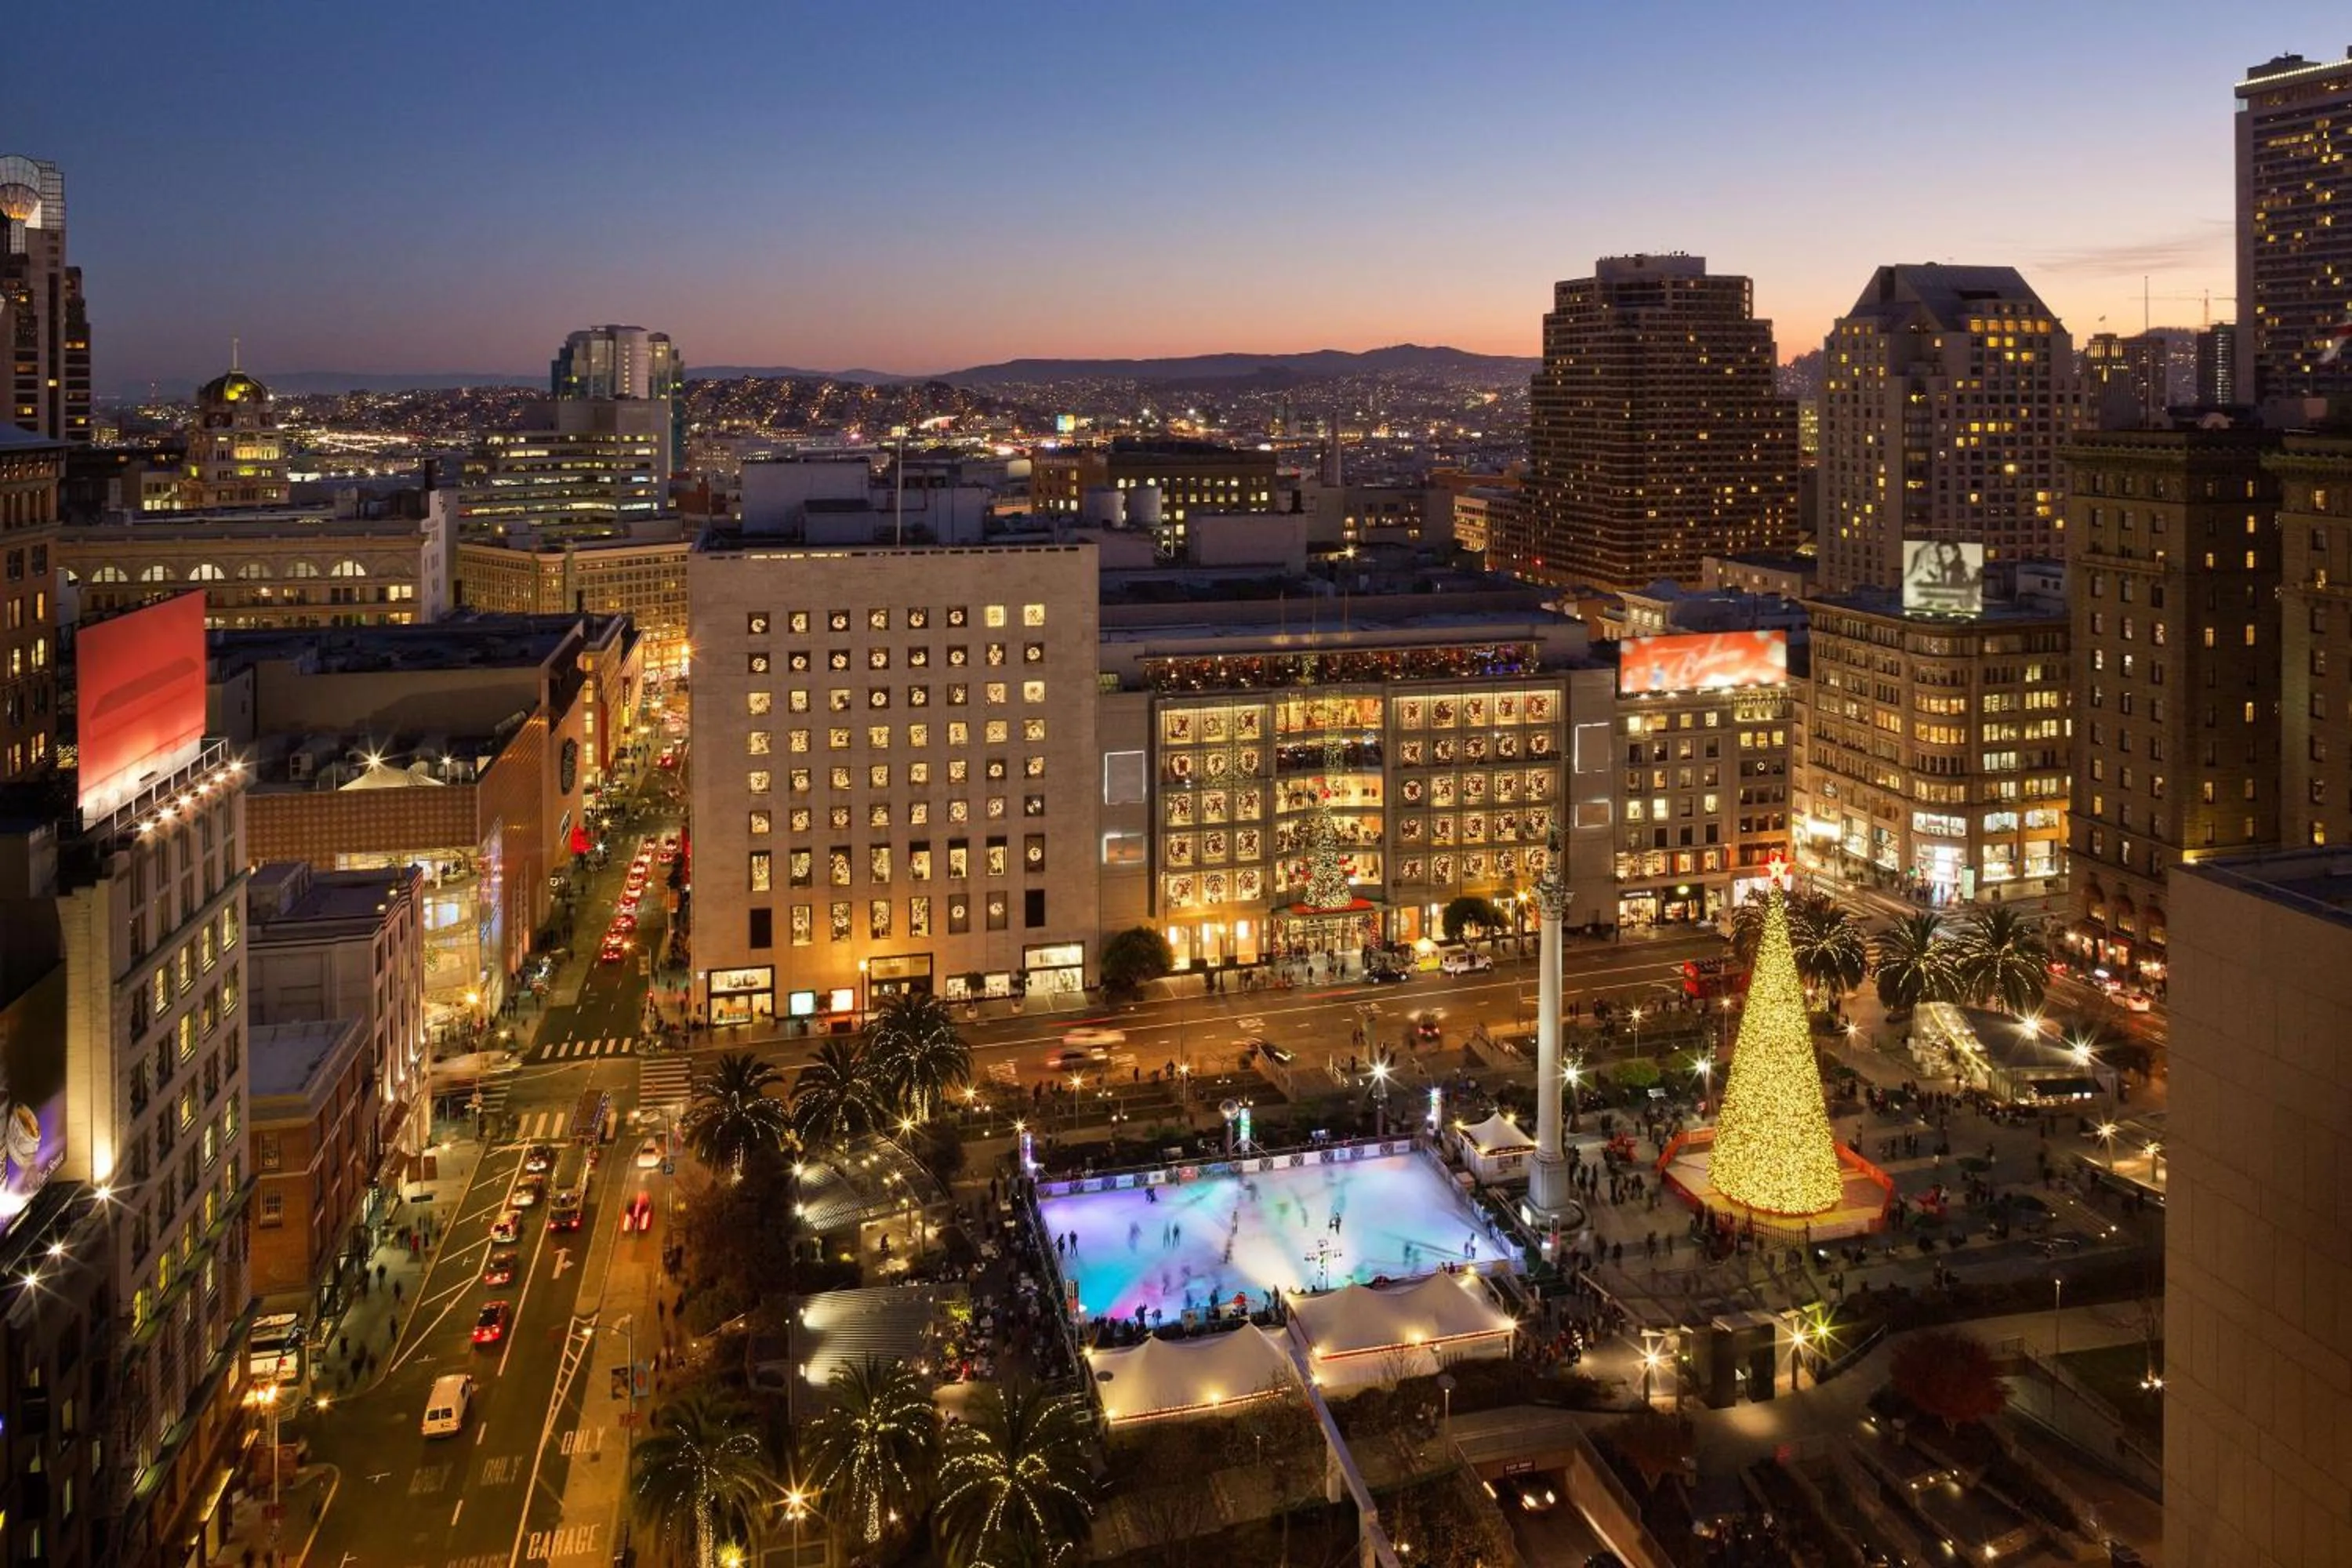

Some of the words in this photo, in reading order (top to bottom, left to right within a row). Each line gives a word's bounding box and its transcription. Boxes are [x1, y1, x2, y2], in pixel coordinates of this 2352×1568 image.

[560, 1425, 605, 1455] ONLY
[481, 1455, 523, 1486] ONLY
[527, 1524, 601, 1559] GARAGE
